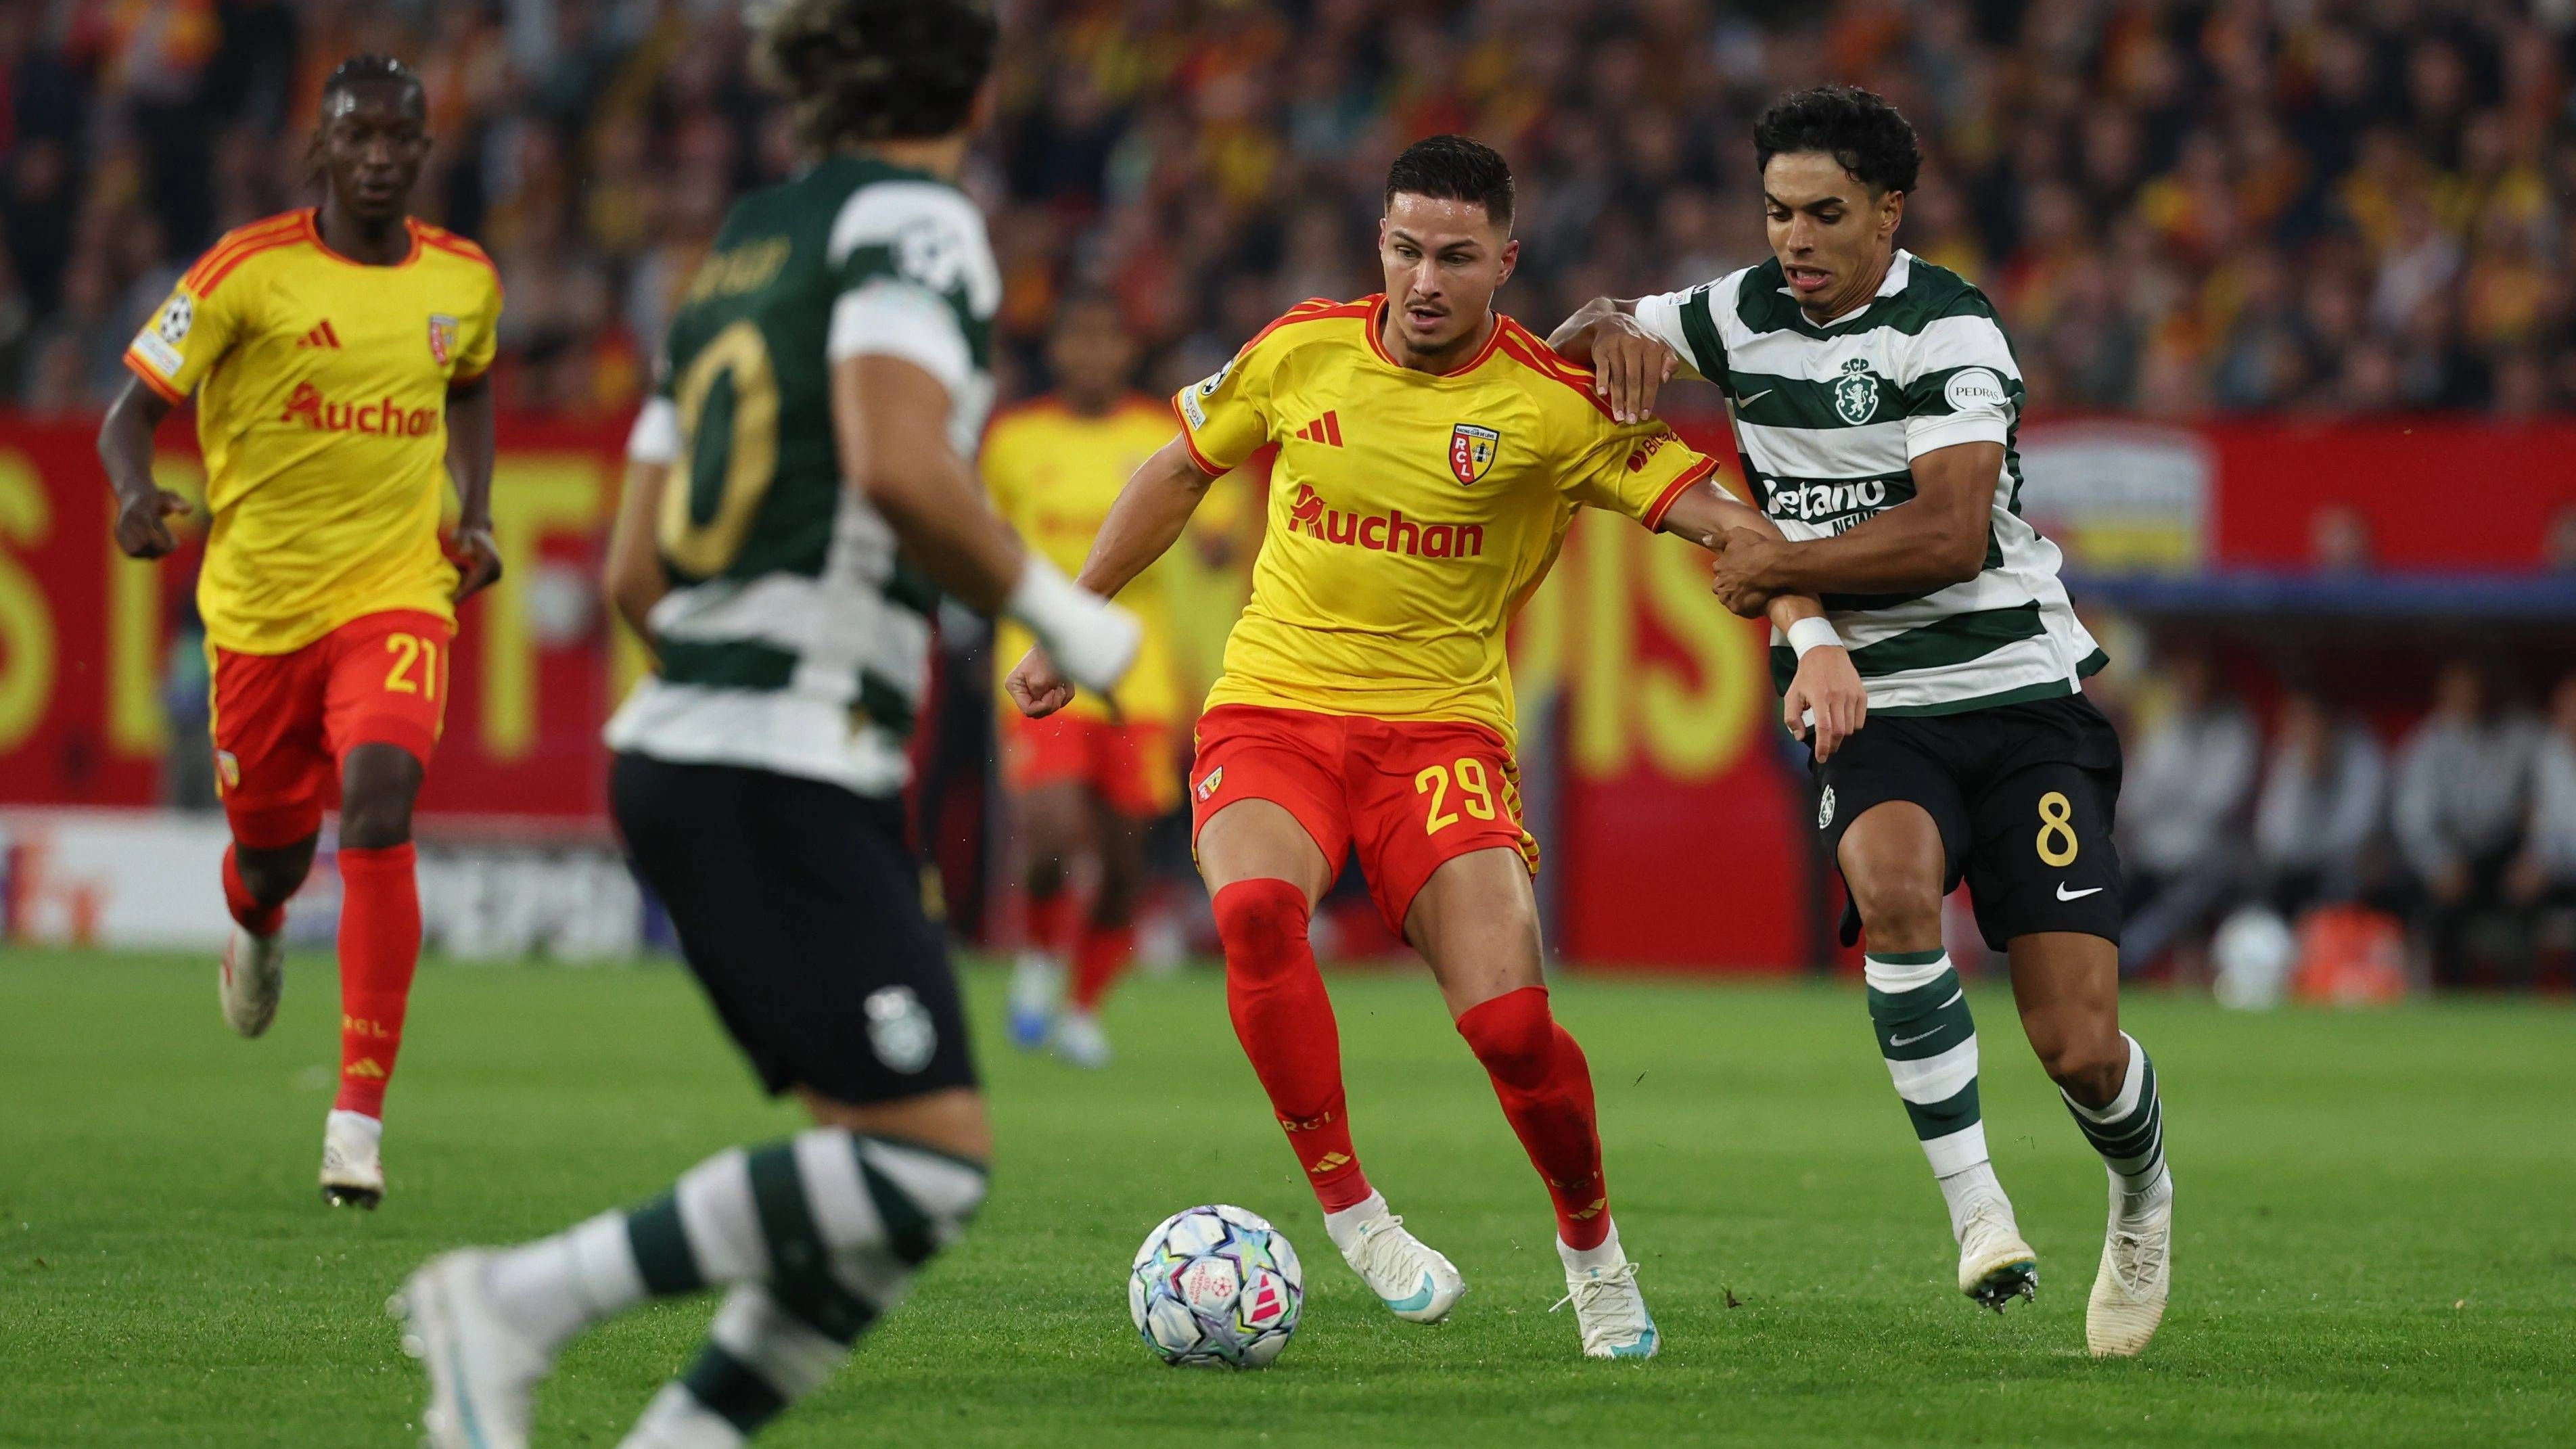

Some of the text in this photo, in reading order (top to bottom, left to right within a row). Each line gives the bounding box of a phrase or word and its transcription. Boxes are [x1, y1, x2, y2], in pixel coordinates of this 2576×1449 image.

[1841, 359, 1869, 375] SCP
[1956, 387, 1999, 401] PEDRAS
[1288, 484, 1484, 558] Auchan
[384, 632, 437, 702] 21
[1414, 758, 1496, 836] 29
[2036, 791, 2078, 867] 8
